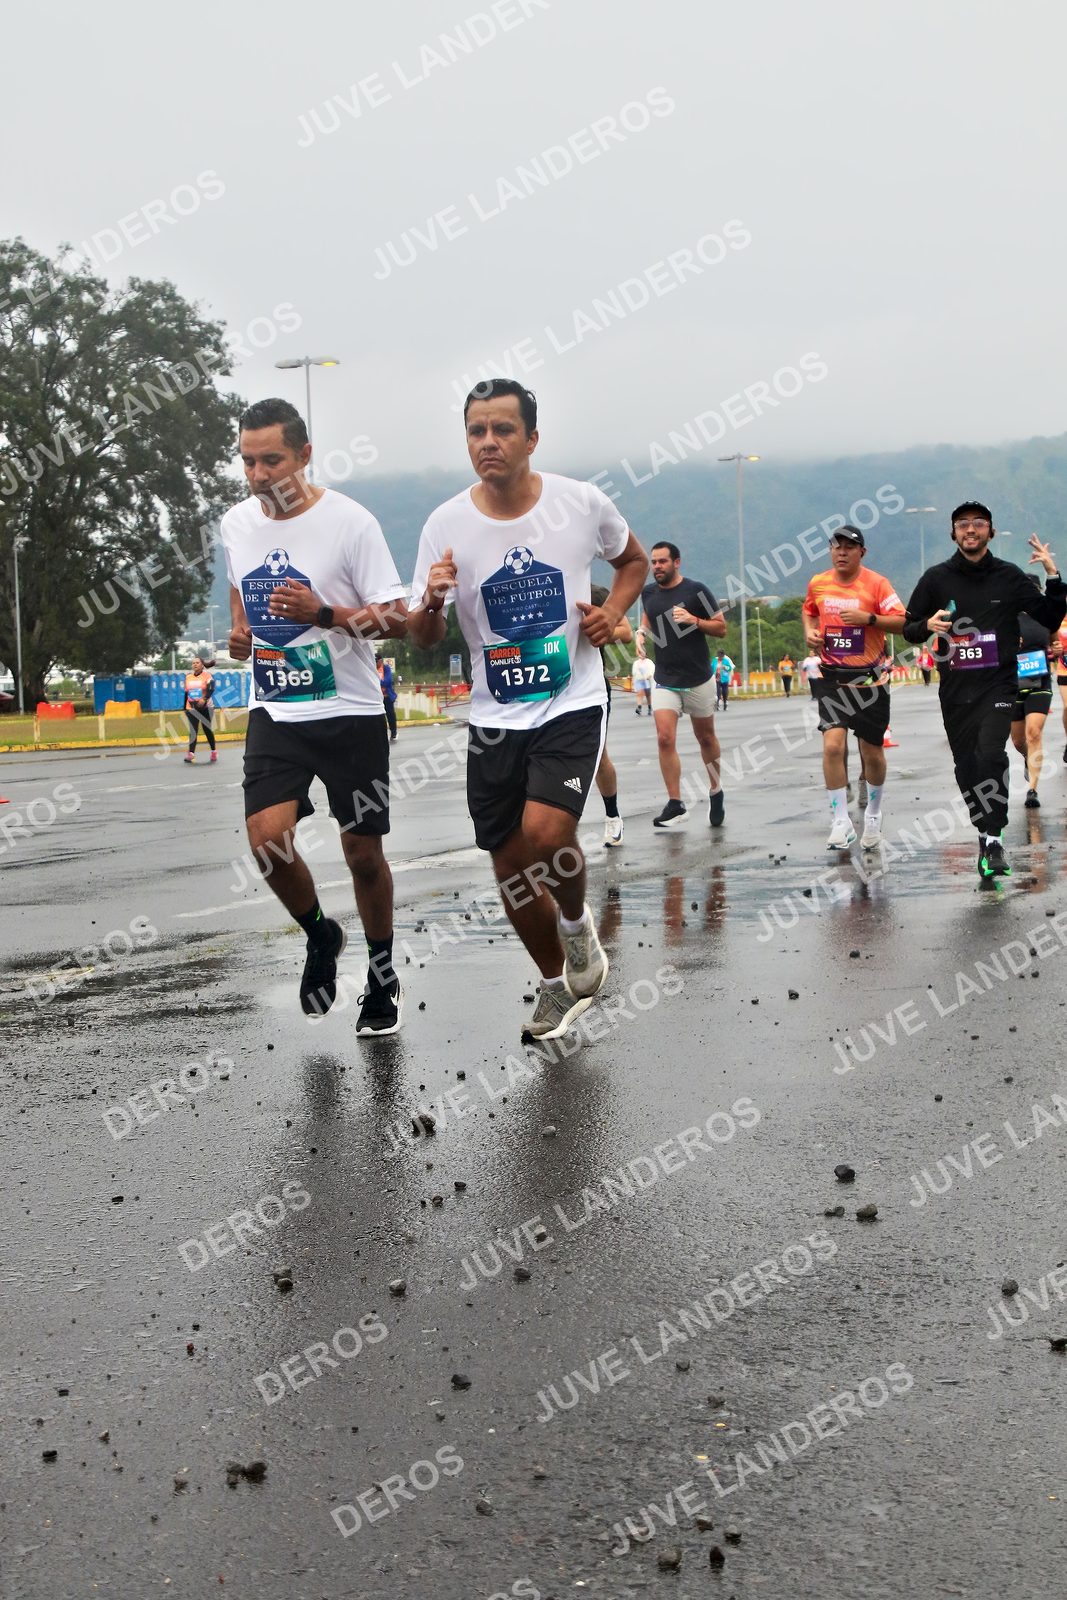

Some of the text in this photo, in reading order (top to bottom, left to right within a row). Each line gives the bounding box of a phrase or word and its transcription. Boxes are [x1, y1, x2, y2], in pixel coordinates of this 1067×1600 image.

[492, 575, 553, 594] ESCUELA
[245, 594, 259, 602] DE
[488, 587, 562, 607] DE FÚTBOL
[543, 641, 560, 655] 10K
[833, 638, 852, 648] 755
[307, 646, 322, 660] 10K
[489, 647, 521, 659] CARRERA
[959, 647, 983, 659] 363
[1020, 661, 1040, 670] 2026
[265, 669, 314, 687] 1369
[501, 665, 551, 686] 1372
